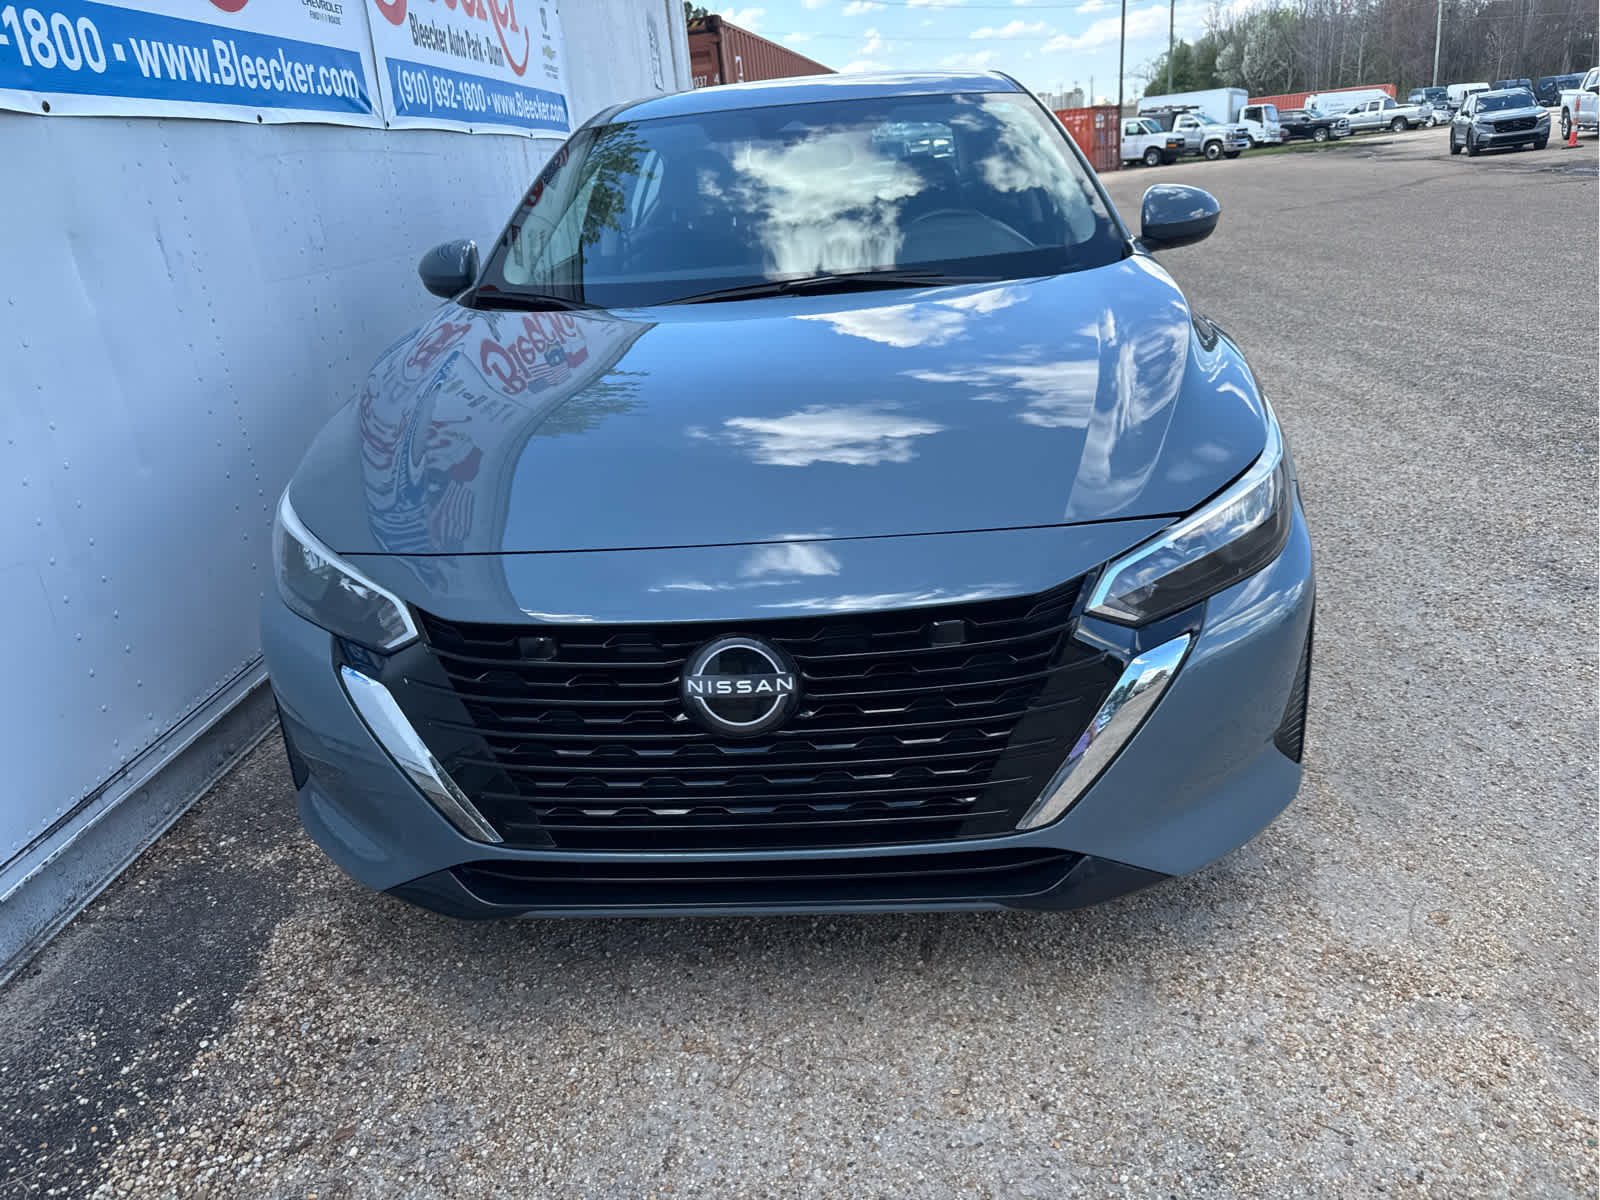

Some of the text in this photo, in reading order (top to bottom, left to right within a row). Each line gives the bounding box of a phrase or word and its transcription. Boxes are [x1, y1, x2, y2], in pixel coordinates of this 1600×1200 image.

[408, 12, 448, 54] Bleecker
[447, 23, 467, 58] Auto
[465, 29, 484, 62] Park
[129, 37, 361, 99] www.Bleecker.com
[397, 65, 566, 122] (910) 892-1800 www.Bleecker.com
[687, 677, 793, 694] NISSAN
